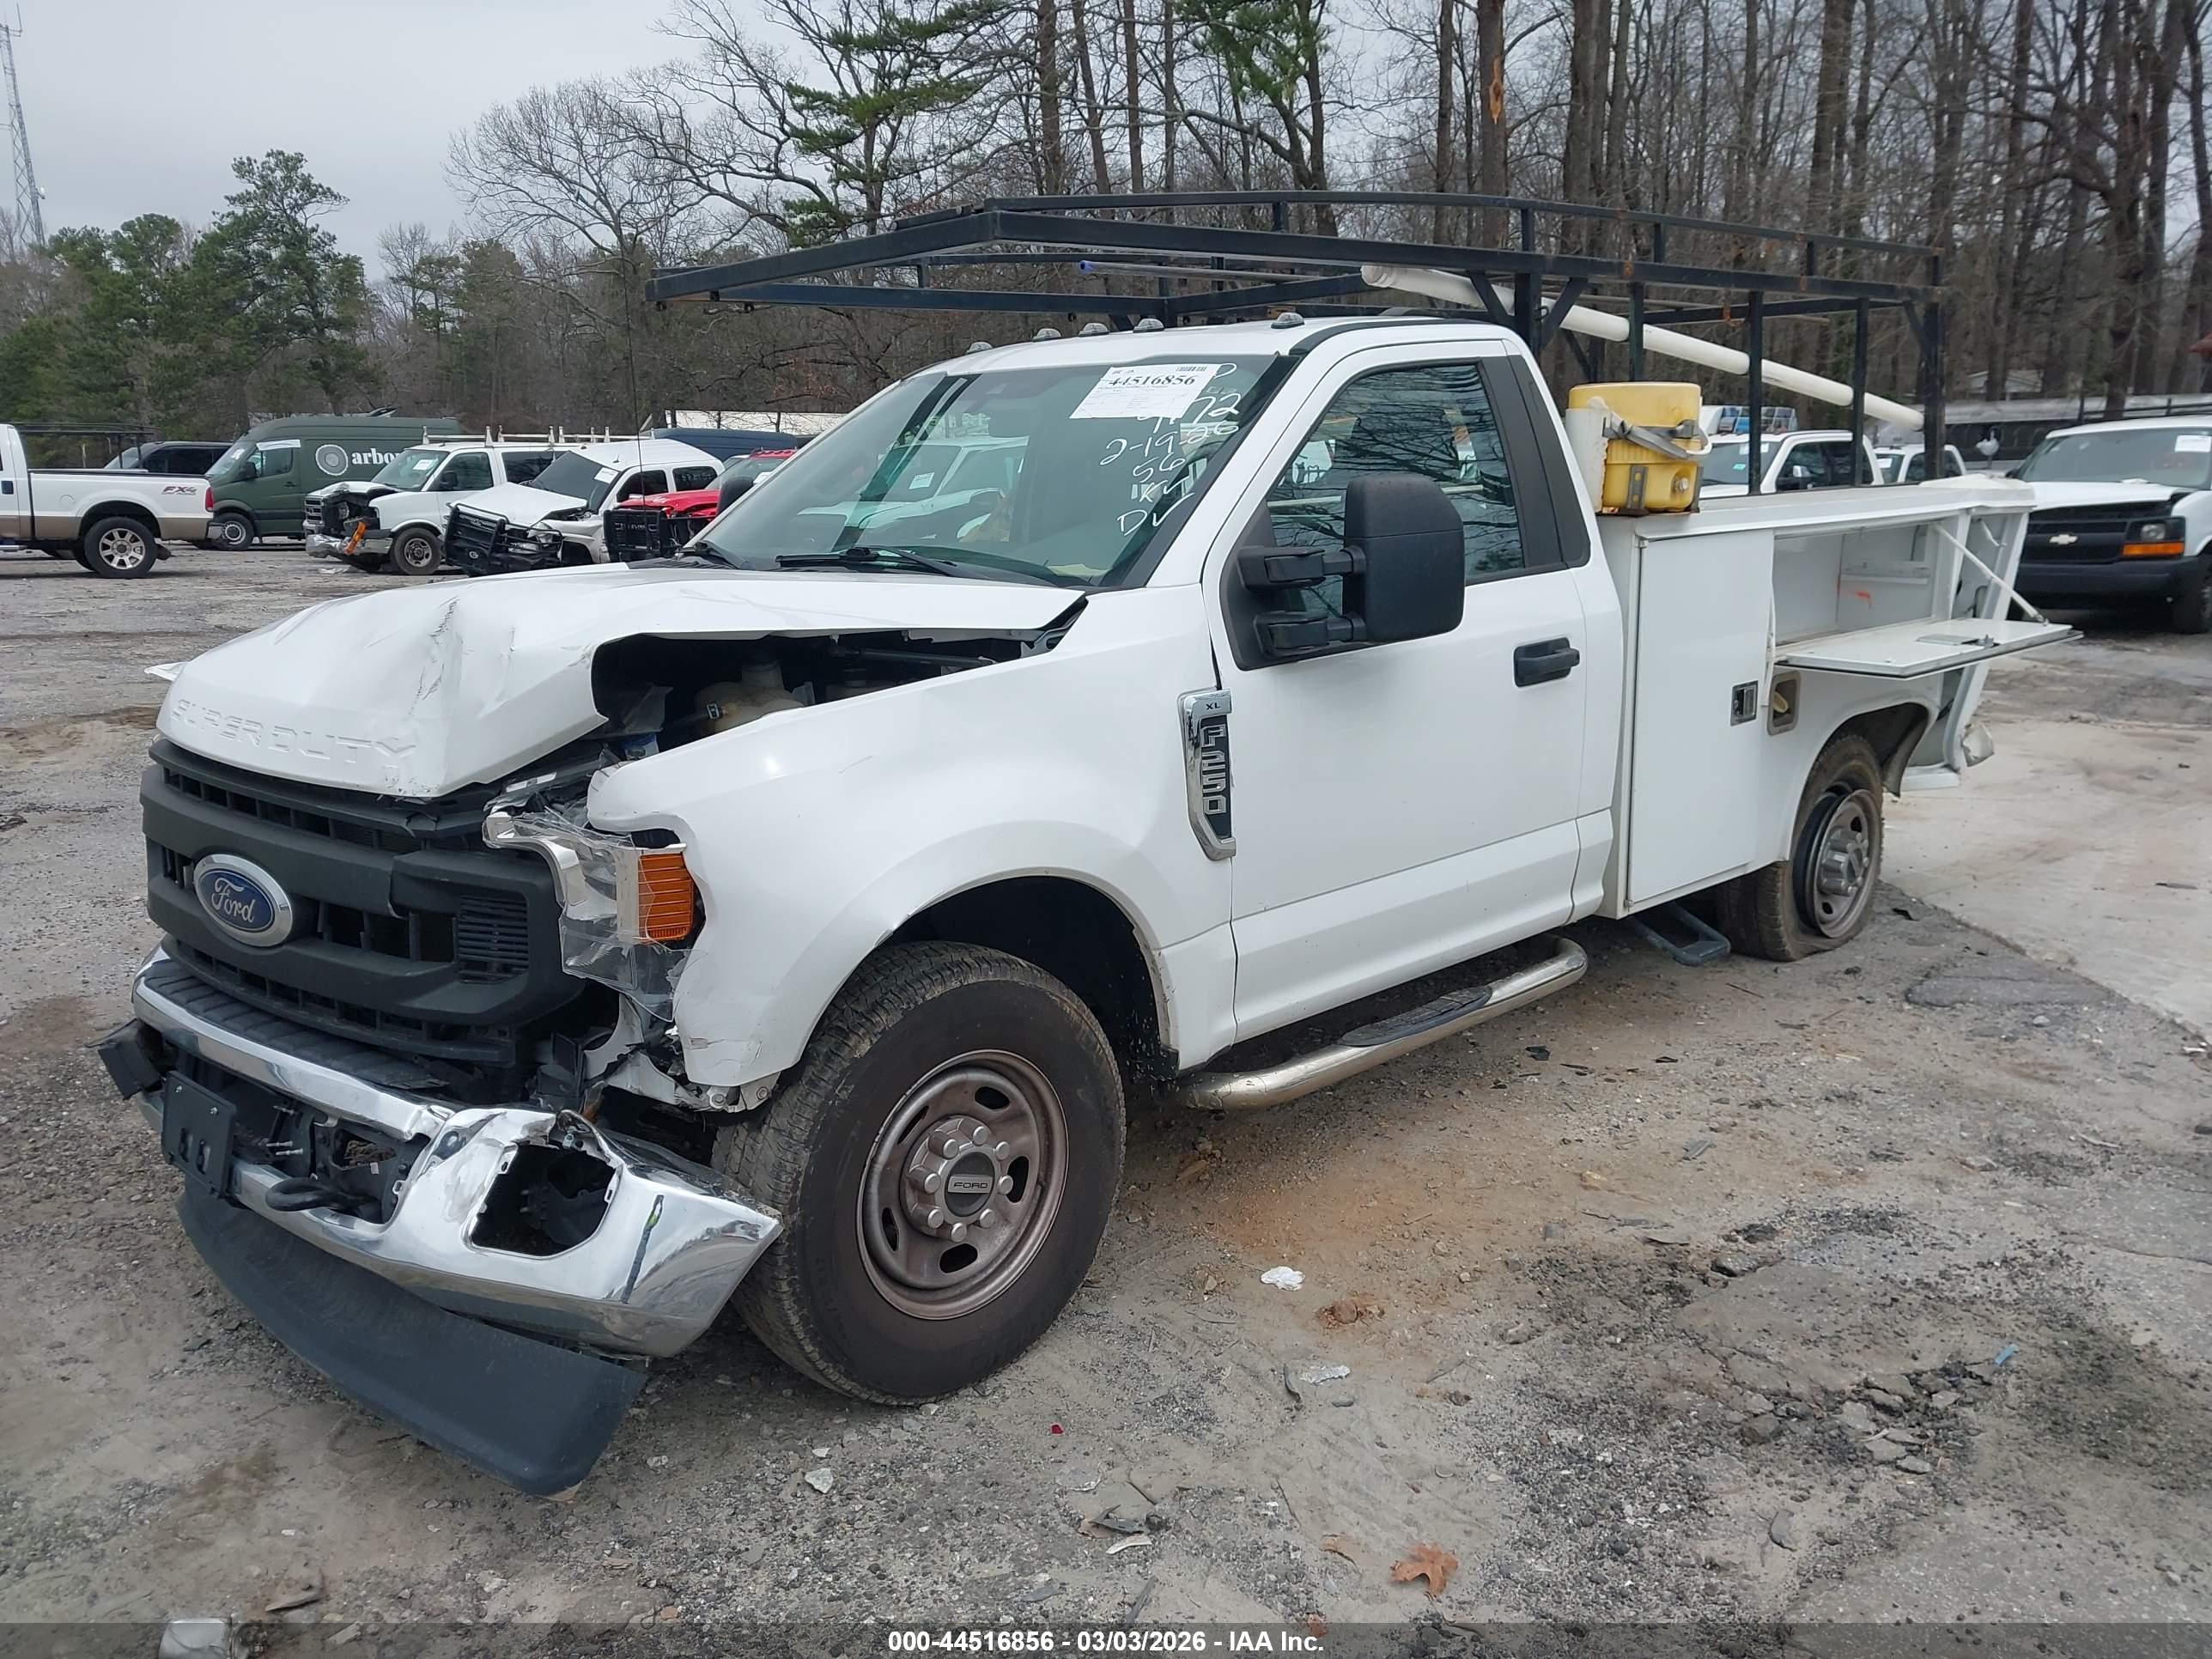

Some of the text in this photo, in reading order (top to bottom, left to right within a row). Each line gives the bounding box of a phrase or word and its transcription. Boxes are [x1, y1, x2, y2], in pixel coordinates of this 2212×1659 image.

[1109, 374, 1196, 386] 44516856
[1100, 420, 1239, 465] 2-19-26
[211, 877, 256, 923] Ford
